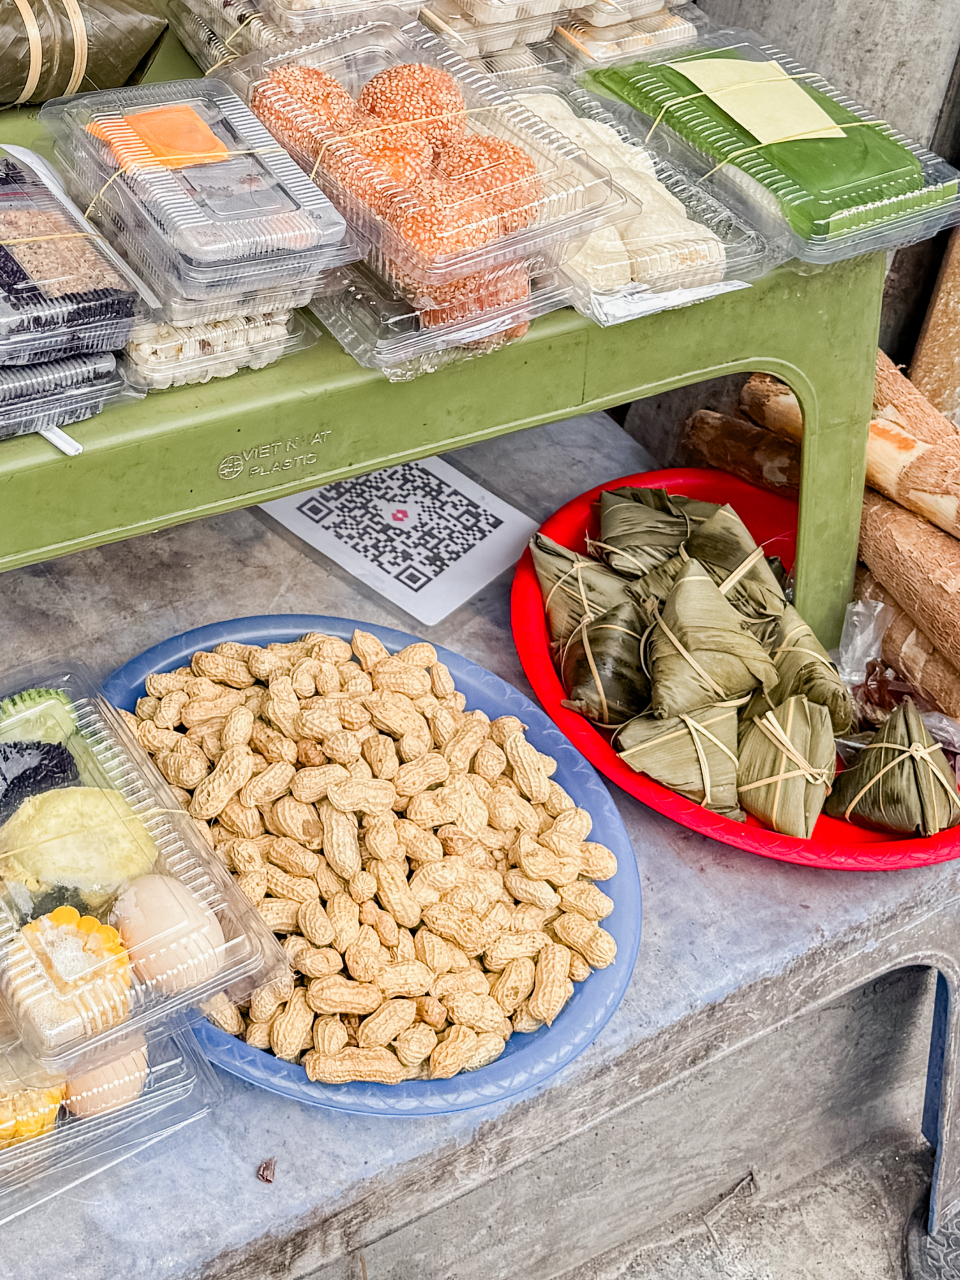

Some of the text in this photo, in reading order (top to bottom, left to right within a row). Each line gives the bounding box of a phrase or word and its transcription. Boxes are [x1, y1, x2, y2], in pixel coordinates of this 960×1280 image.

[242, 430, 332, 461] VIET NAT
[249, 452, 318, 477] PLASTIC
